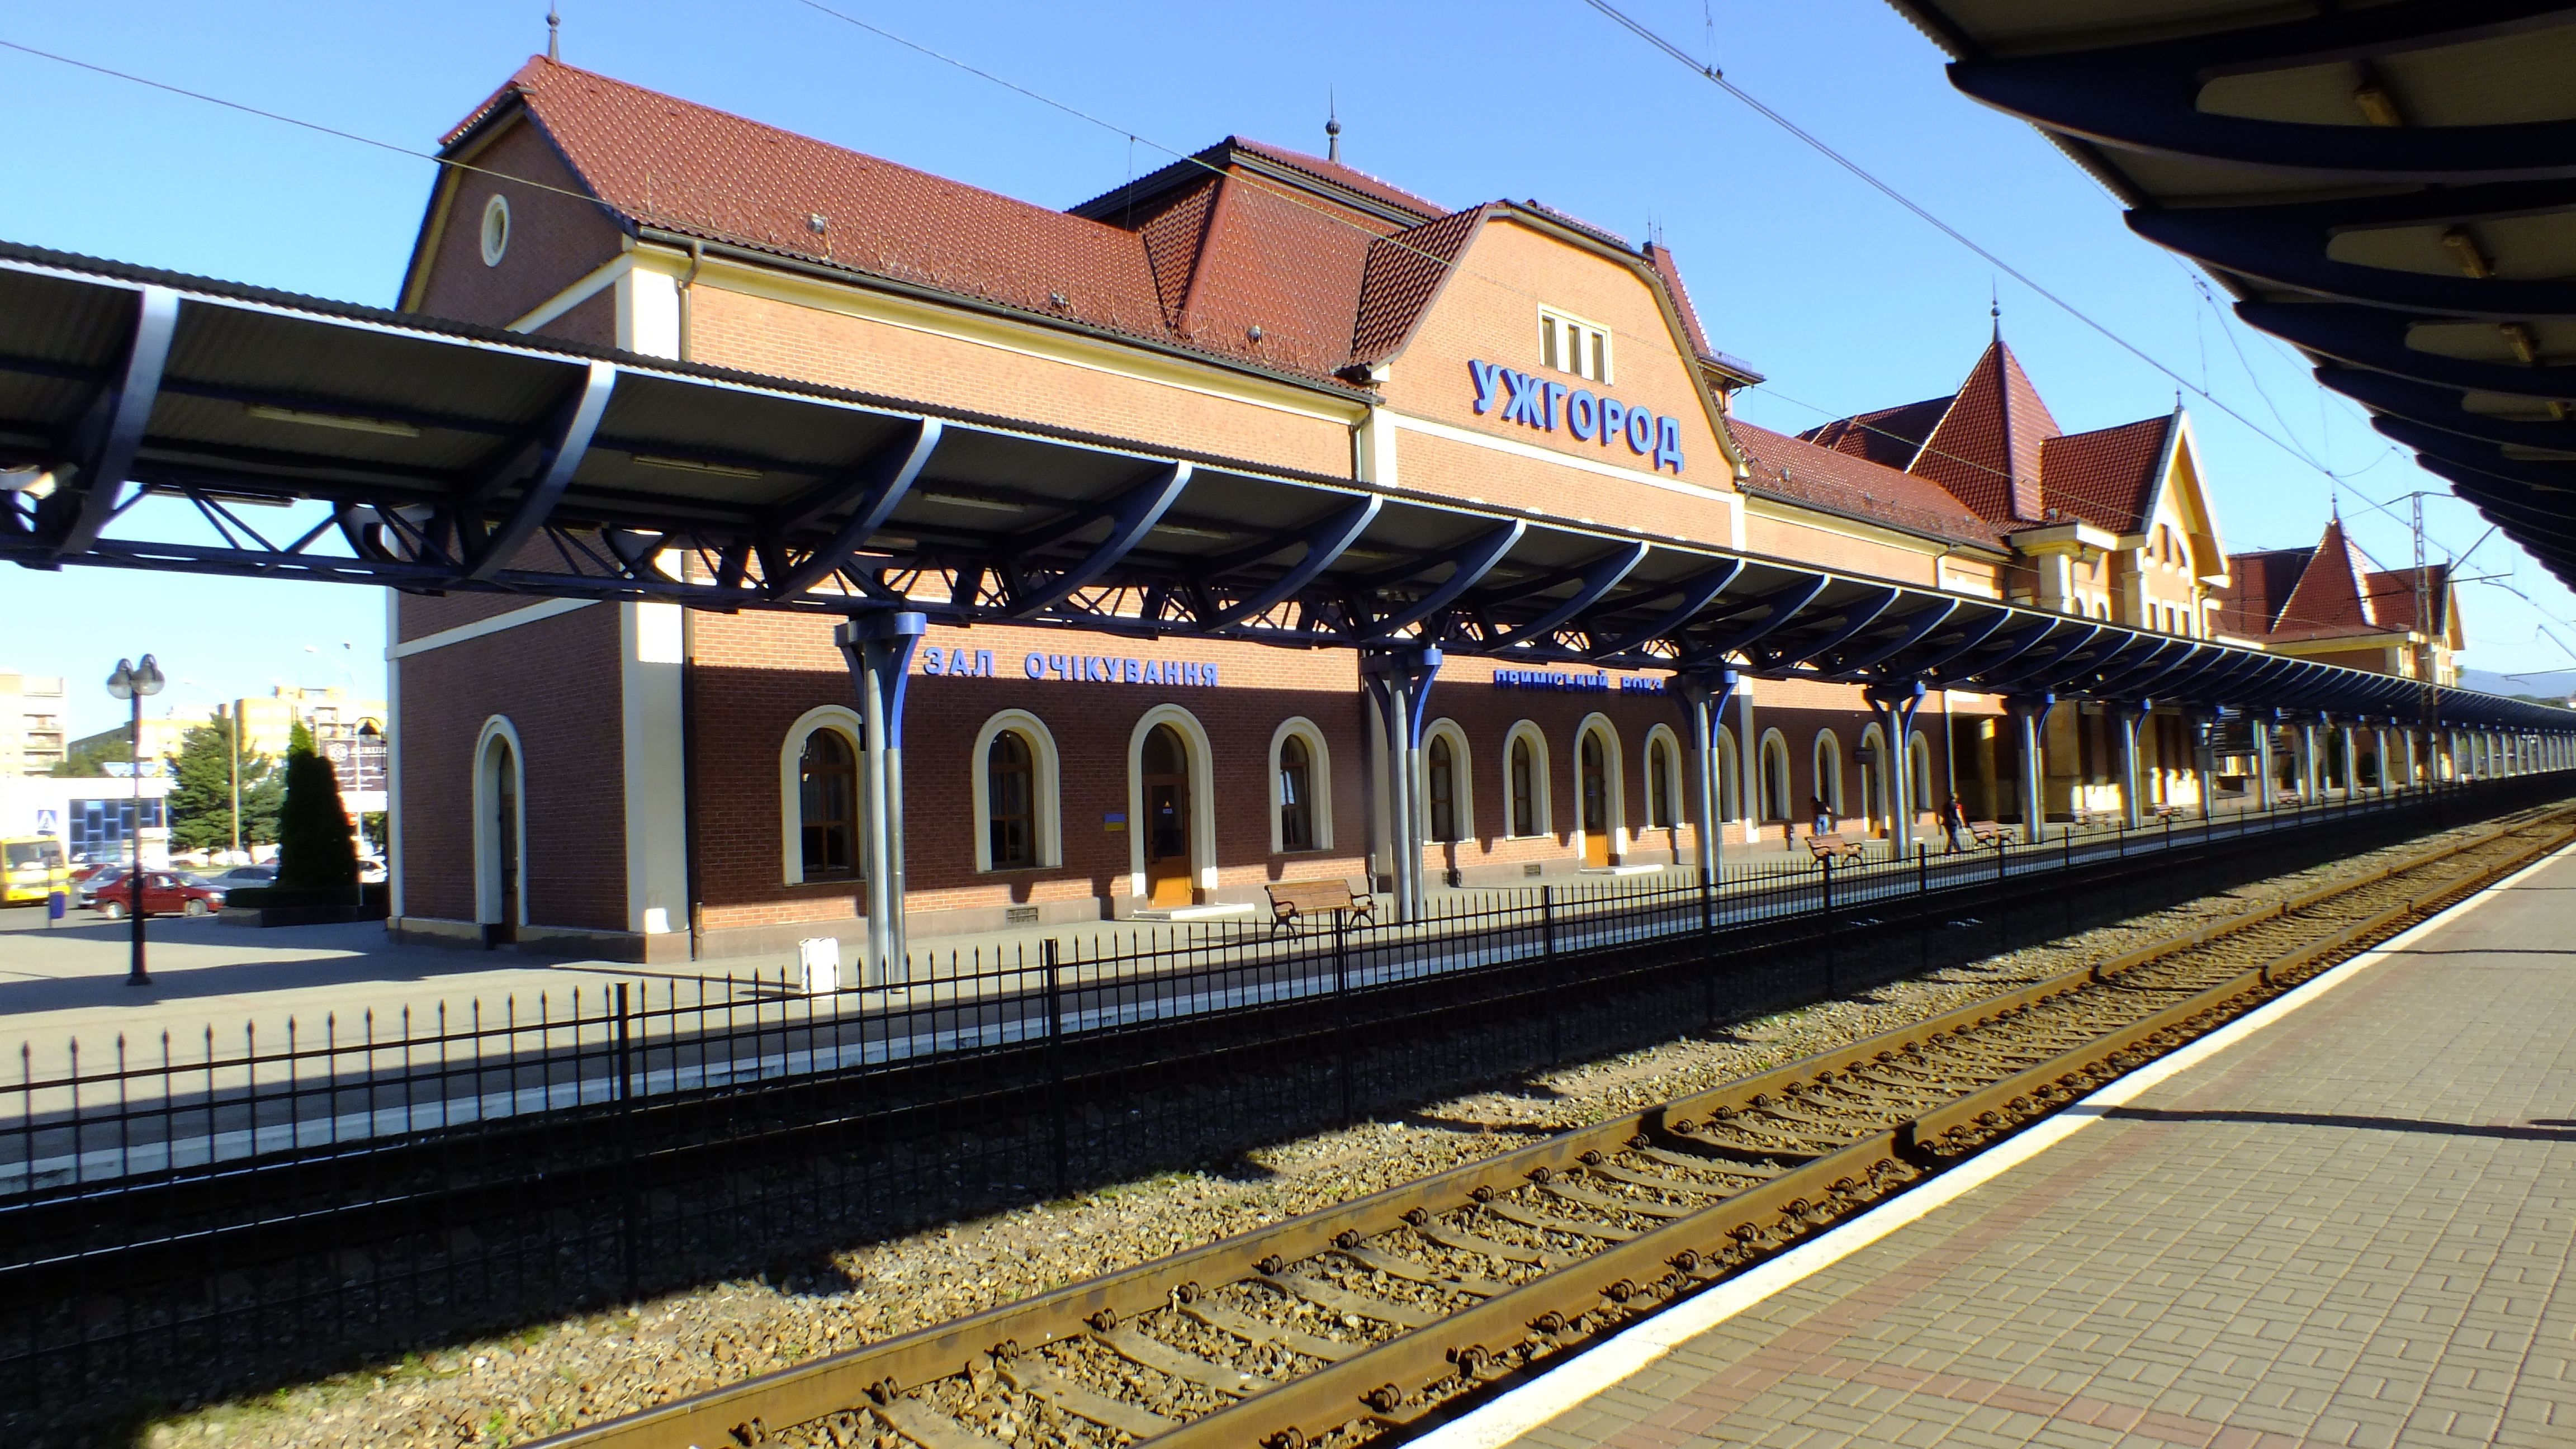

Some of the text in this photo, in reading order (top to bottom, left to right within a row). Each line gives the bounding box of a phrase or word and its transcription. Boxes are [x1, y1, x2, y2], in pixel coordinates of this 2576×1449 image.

[1469, 359, 1684, 473] УЖГОРОД
[924, 647, 1218, 686] ЗАЛ ОЧІКУВАННЯ
